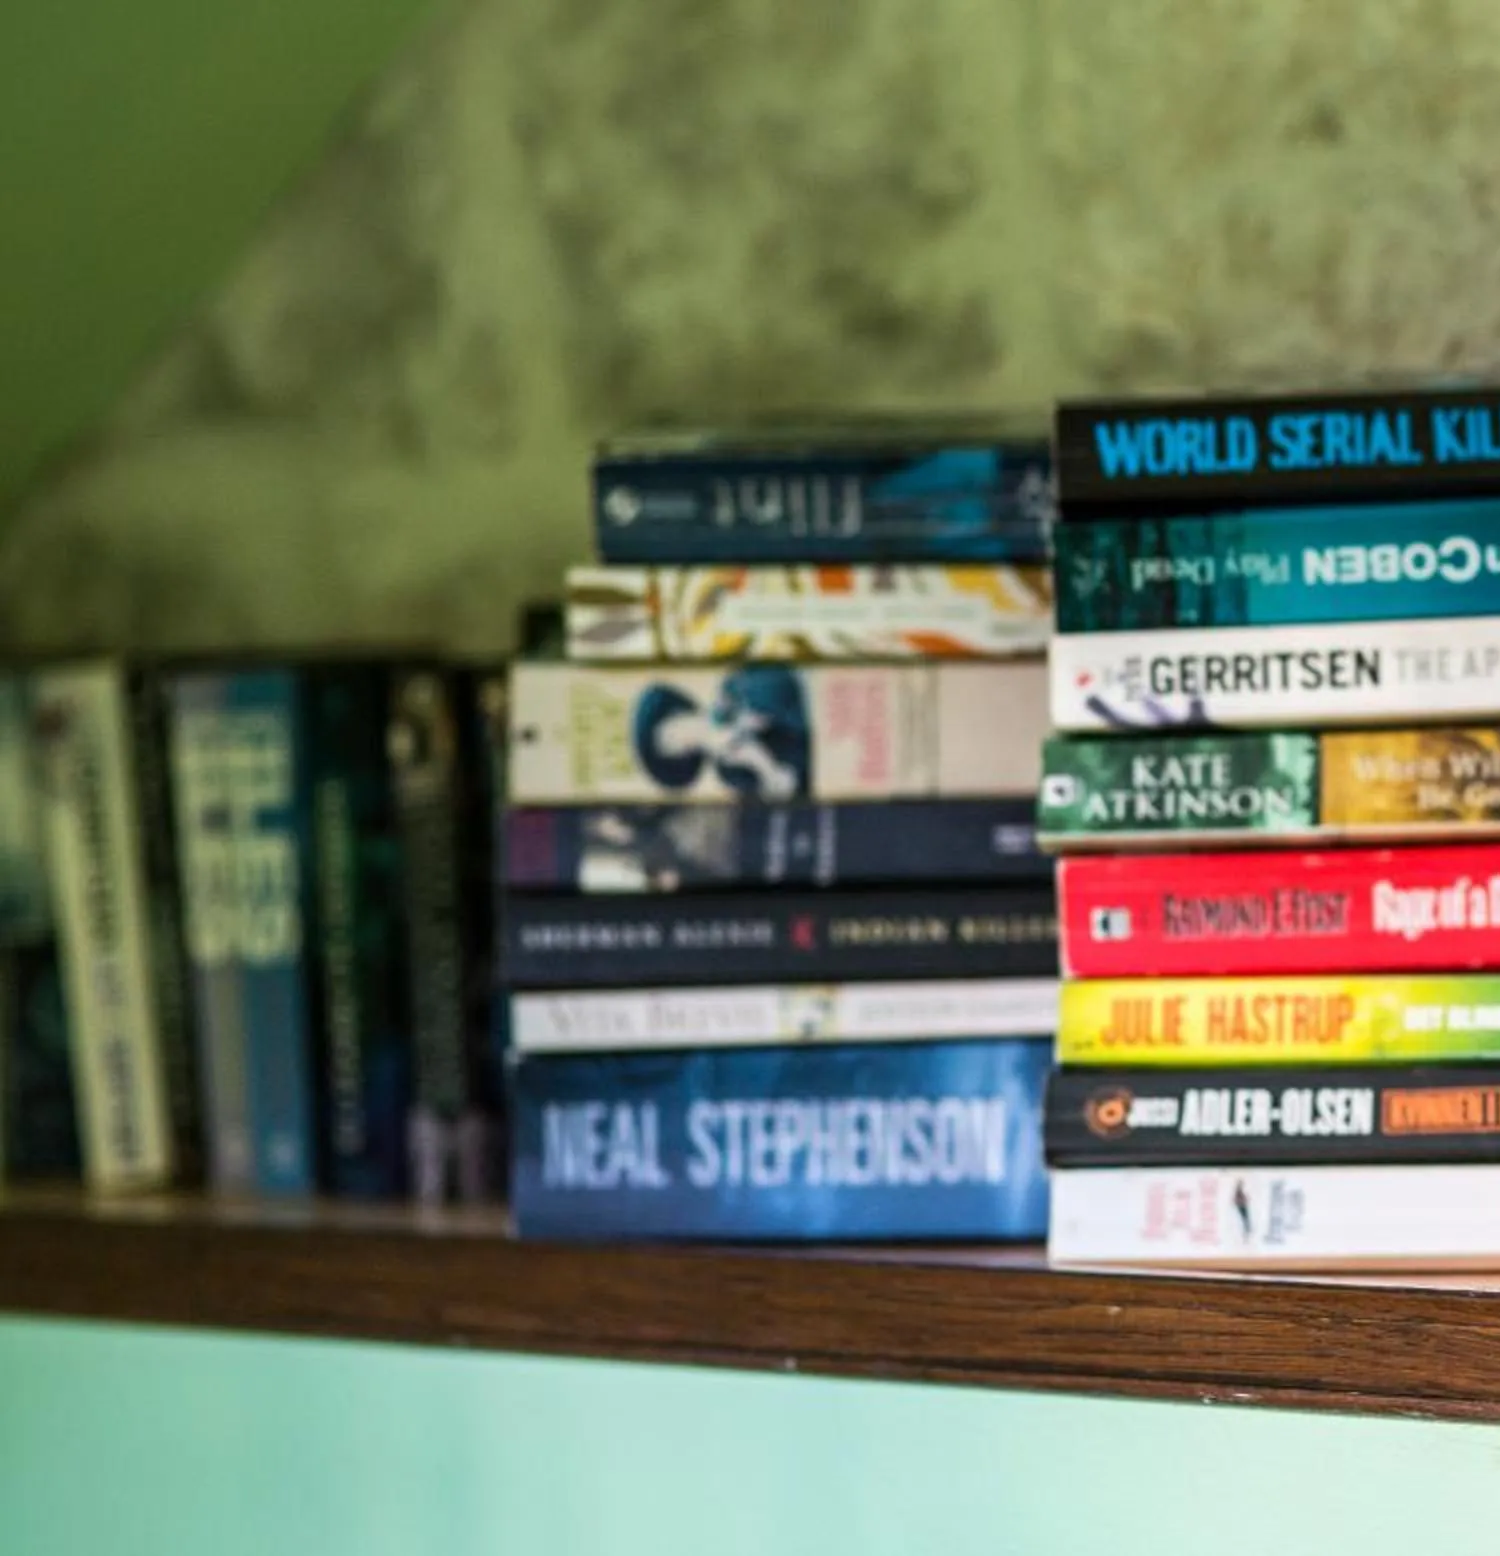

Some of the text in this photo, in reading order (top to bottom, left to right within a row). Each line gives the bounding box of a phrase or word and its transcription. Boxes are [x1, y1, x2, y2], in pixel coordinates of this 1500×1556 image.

[1097, 417, 1259, 478] WORLD
[1269, 411, 1422, 468] SERIAL
[1303, 534, 1482, 587] COBEN
[1150, 649, 1382, 697] GERRITSEN
[1131, 755, 1232, 789] KATE
[1082, 789, 1292, 822] ATKINSON
[1103, 998, 1187, 1048] JULIE
[1207, 994, 1354, 1047] HASTRUP
[1179, 1089, 1374, 1135] ADLER-OLSEN
[542, 1096, 1003, 1188] NEAL STEPHENSON
